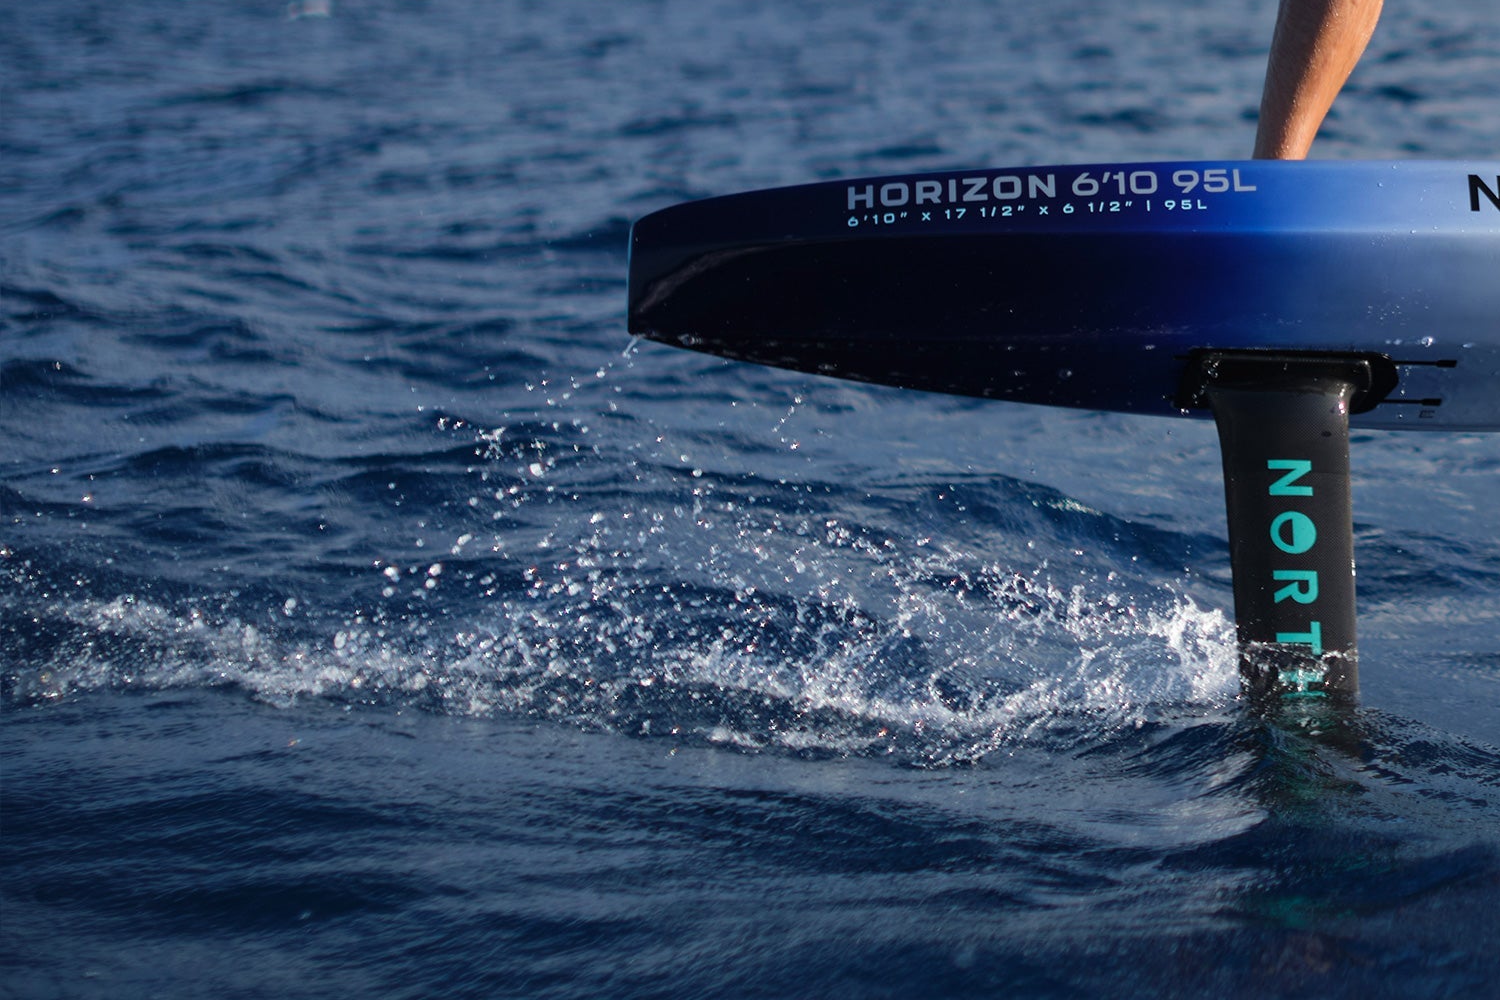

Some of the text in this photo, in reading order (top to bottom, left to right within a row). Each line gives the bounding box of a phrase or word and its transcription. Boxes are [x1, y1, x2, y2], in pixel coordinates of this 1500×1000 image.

[848, 168, 1258, 210] HORIZON 6'10 95L
[944, 208, 967, 220] 17
[1062, 203, 1075, 214] 6
[1164, 198, 1208, 211] 95L
[1267, 458, 1326, 698] NORTH
